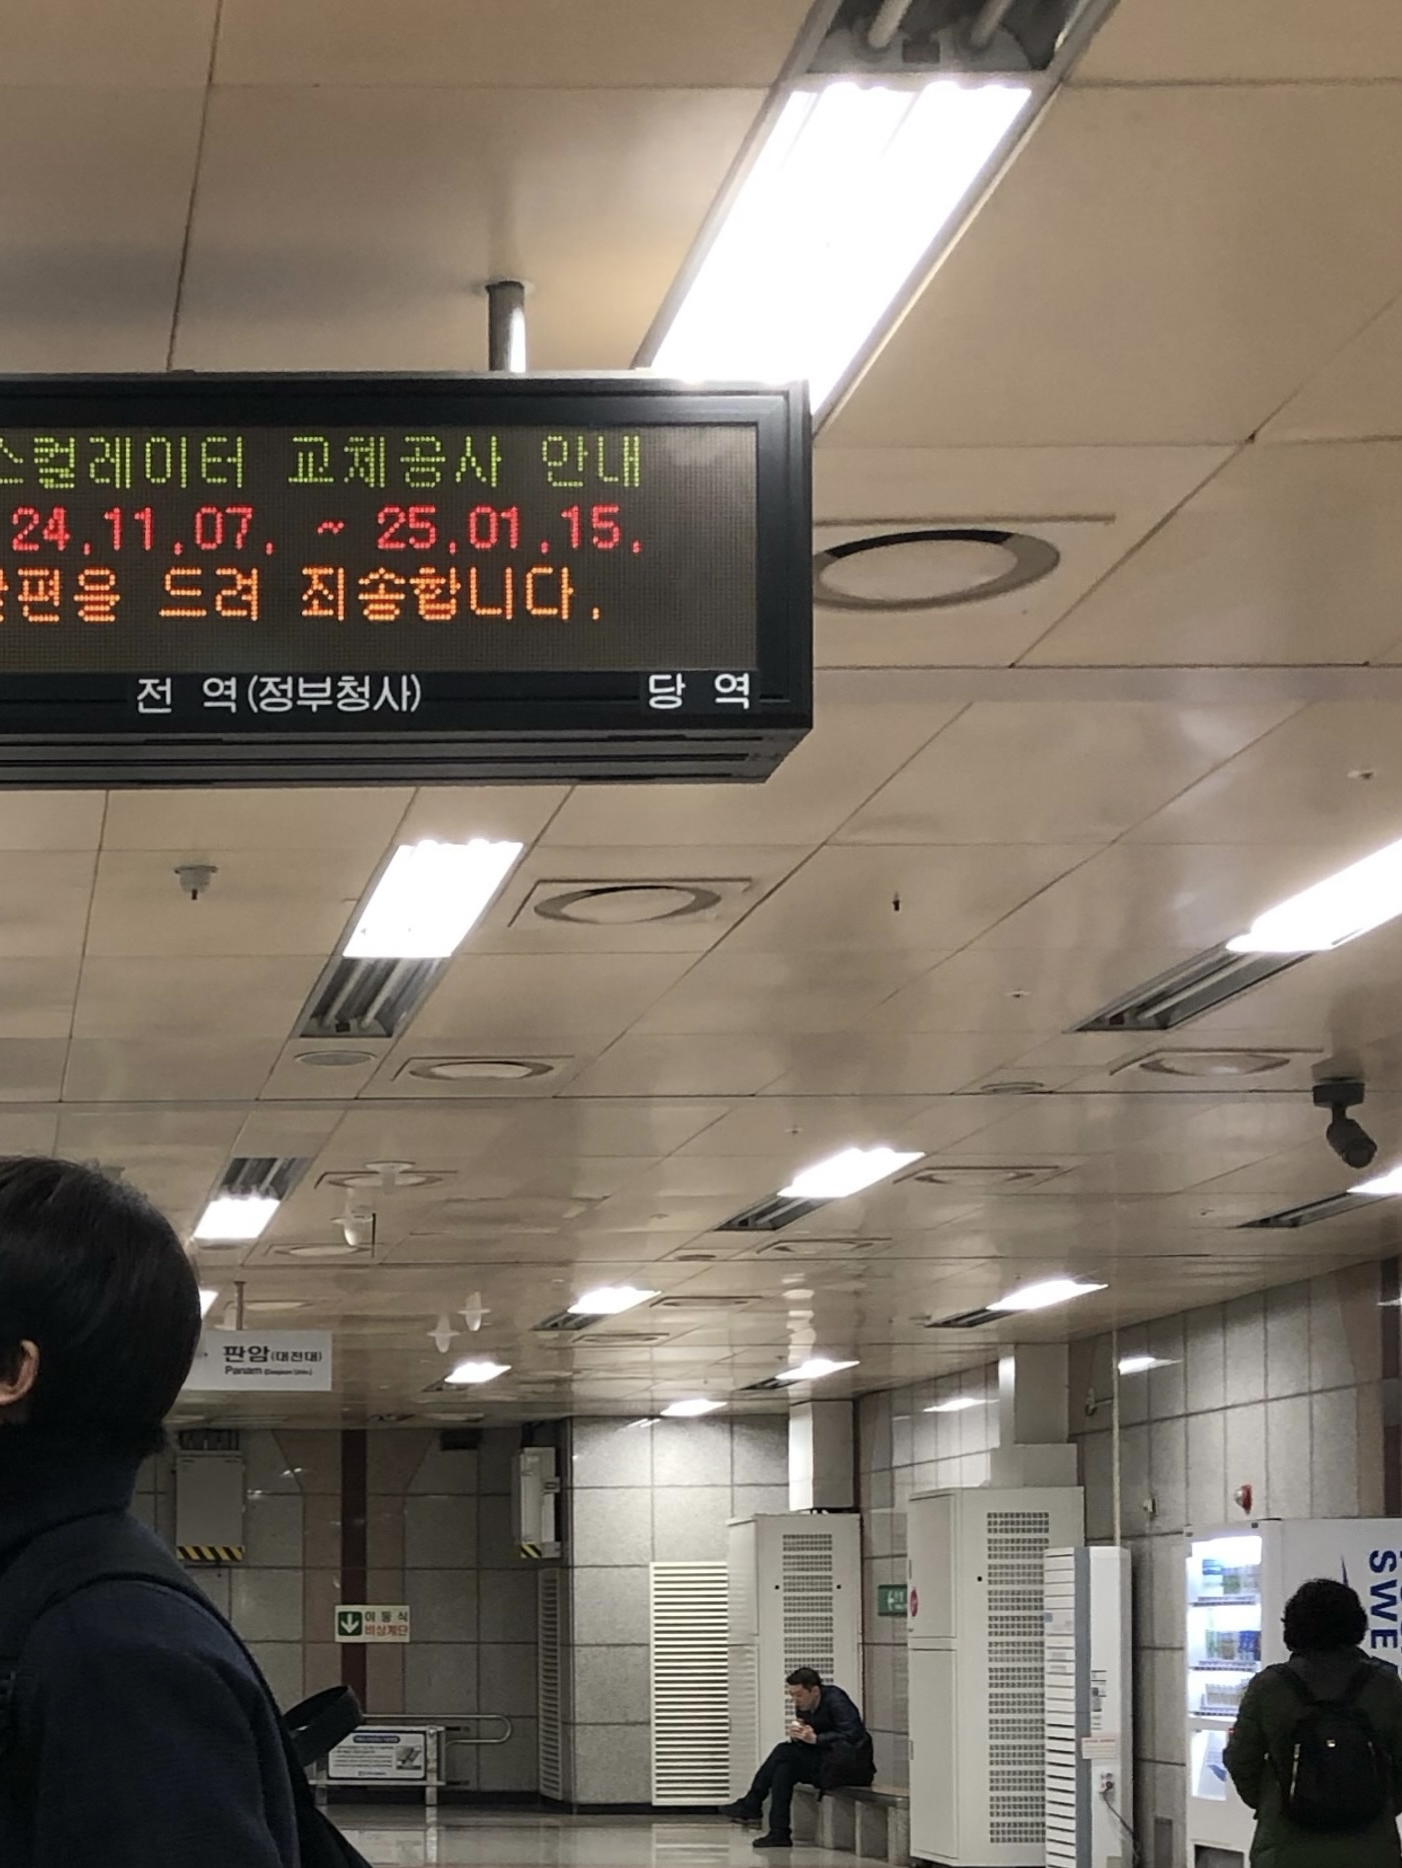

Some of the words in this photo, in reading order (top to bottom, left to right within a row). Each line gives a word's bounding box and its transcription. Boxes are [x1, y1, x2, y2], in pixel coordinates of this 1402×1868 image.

[288, 436, 502, 488] 교체공사
[541, 435, 640, 488] 안내
[159, 568, 259, 622] 드려
[301, 566, 600, 622] 죄송합니다.
[224, 1365, 263, 1375] Panam
